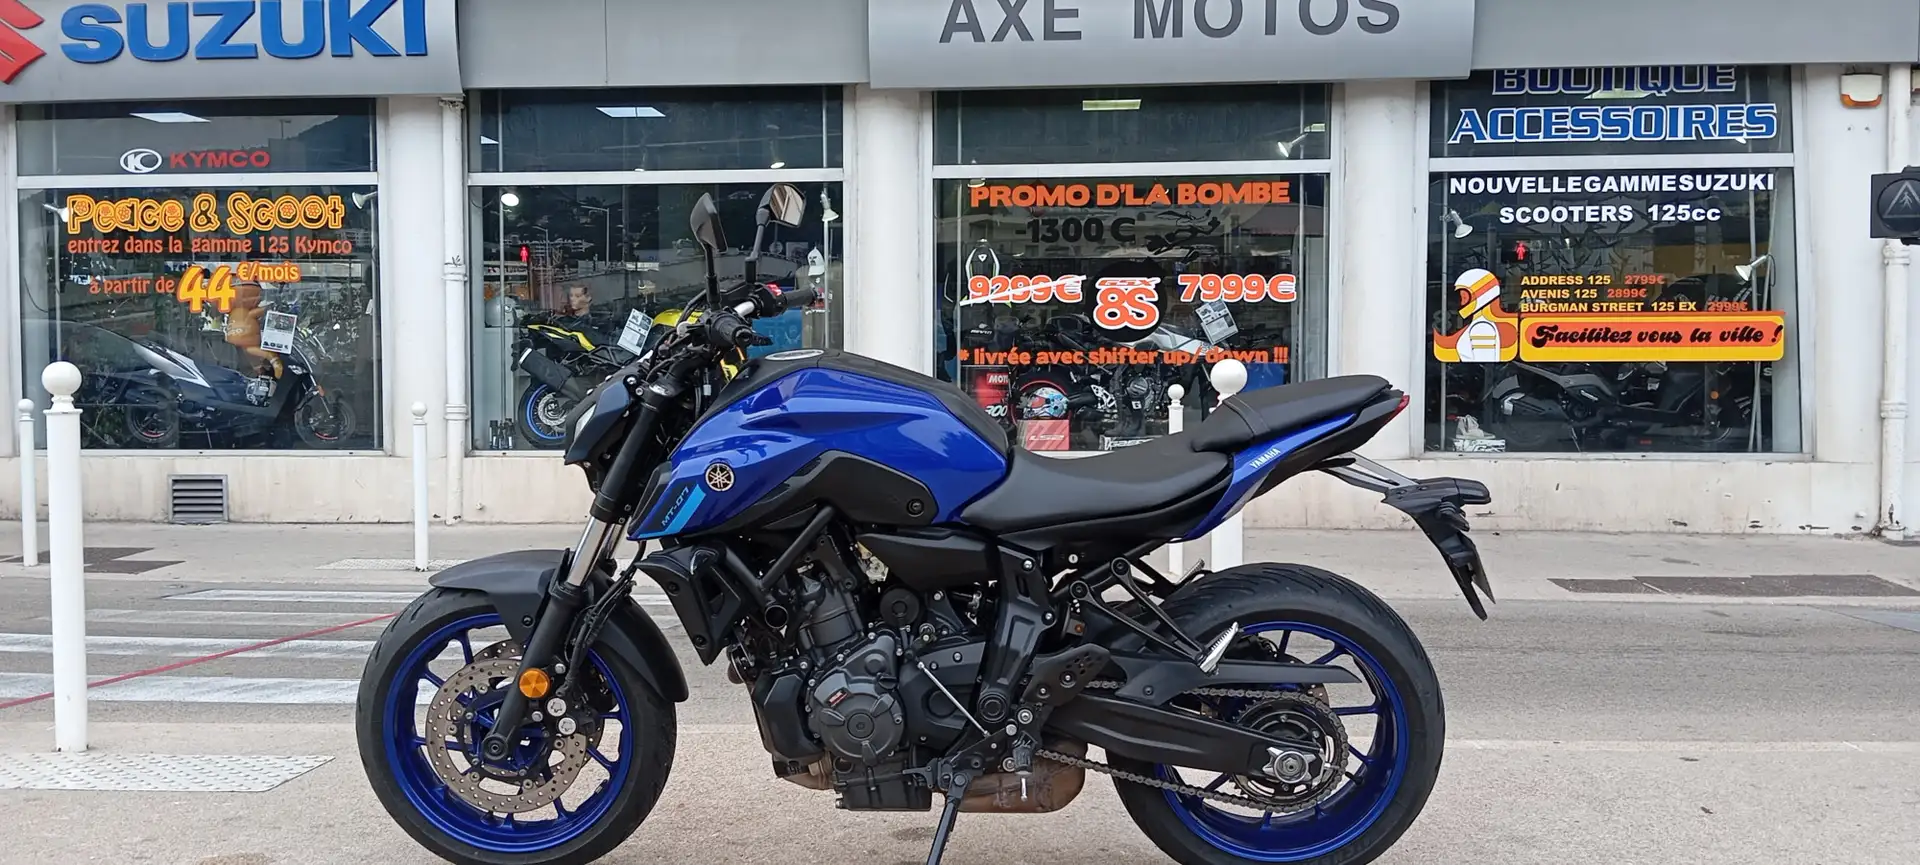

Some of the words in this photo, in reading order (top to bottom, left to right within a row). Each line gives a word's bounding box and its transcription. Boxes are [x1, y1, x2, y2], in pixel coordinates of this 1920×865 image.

[60, 0, 428, 63] SUZUKI
[938, 0, 1082, 43] AXE
[1133, 0, 1399, 39] MOTOS
[1493, 65, 1736, 96] BOUTIQUE
[1448, 103, 1777, 144] ACCESSOIRES
[169, 150, 270, 169] KYMCO
[970, 185, 1090, 207] PROMO
[1096, 184, 1171, 206] D'LA
[1177, 182, 1290, 205] BOMBE
[67, 194, 184, 234] Peace
[190, 193, 220, 233] &
[227, 192, 345, 234] Scoot
[1499, 205, 1633, 223] SCOOTERS
[1648, 204, 1721, 221] 125cc
[1015, 217, 1104, 243] -1300
[68, 237, 119, 253] entrez
[124, 235, 162, 253] dans
[168, 235, 183, 253] la
[191, 237, 252, 254] gamme
[258, 236, 289, 252] 125
[295, 235, 352, 255] Kymco
[89, 276, 101, 295] à
[104, 276, 148, 296] partir
[155, 275, 175, 294] de
[177, 265, 236, 313] 44
[237, 261, 300, 282] €/mois
[1178, 274, 1297, 303] 7999€
[1521, 275, 1583, 286] ADDRESS
[1587, 275, 1611, 285] 125
[1624, 275, 1665, 285] 2799€
[1520, 289, 1570, 299] AVENIS
[1573, 288, 1597, 299] 125
[1607, 288, 1647, 298] 2899€
[1093, 287, 1159, 330] 8S
[1520, 302, 1588, 313] BURGMAN
[1592, 302, 1644, 312] STREET
[1651, 301, 1675, 312] 125
[1679, 301, 1697, 312] EX
[1532, 325, 1632, 348] Facilitez
[1637, 329, 1682, 343] vous
[1690, 328, 1712, 343] la
[1719, 326, 1764, 343] ville
[974, 347, 1031, 365] livrée
[1036, 350, 1084, 365] avec
[1089, 347, 1158, 365] shifter
[1249, 447, 1281, 469] YAMAHA
[661, 486, 689, 526] MT-07
